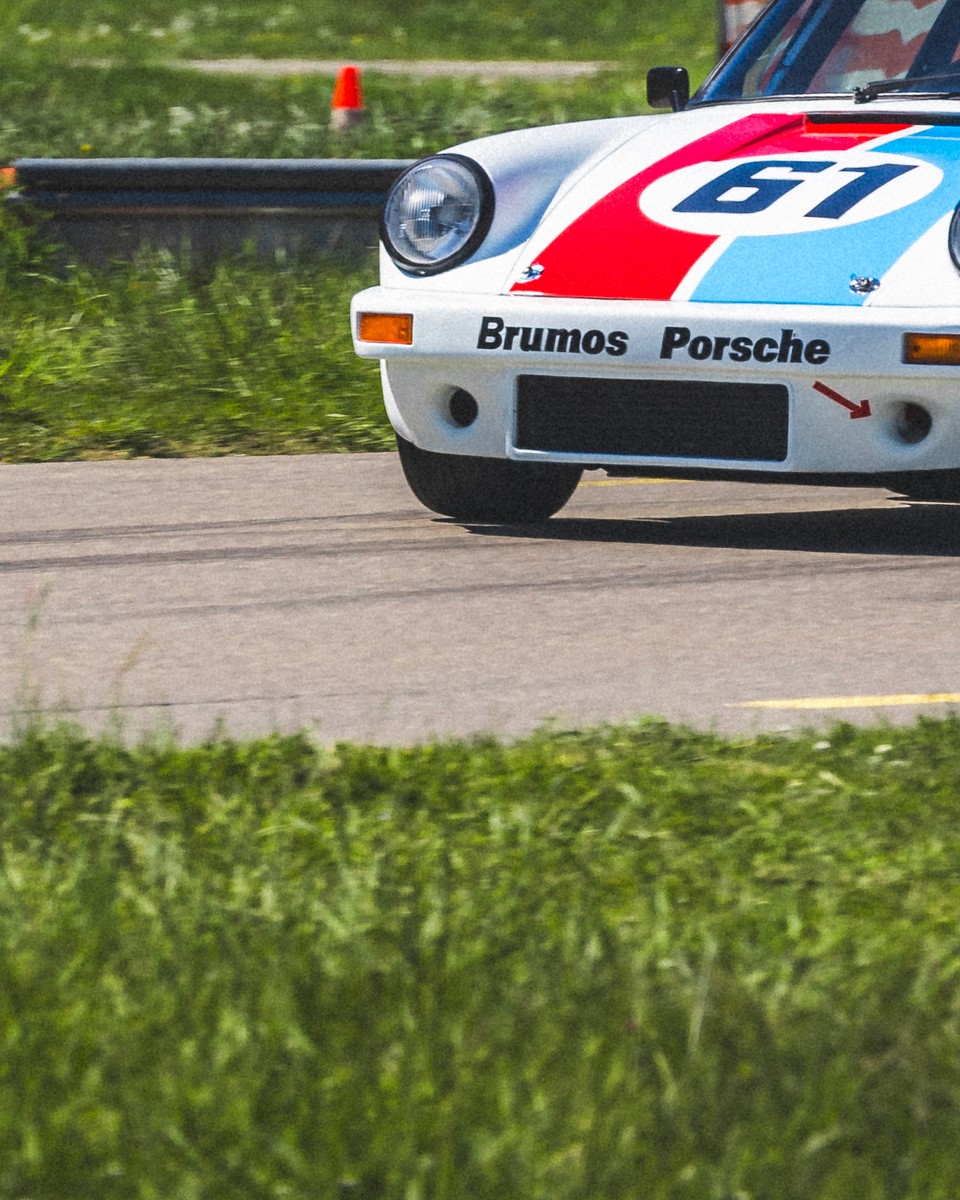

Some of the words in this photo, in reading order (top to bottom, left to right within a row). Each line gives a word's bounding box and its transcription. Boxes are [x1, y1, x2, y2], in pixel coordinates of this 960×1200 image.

[671, 160, 920, 220] 61
[476, 316, 630, 357] Brumos
[659, 326, 831, 365] Porsche
